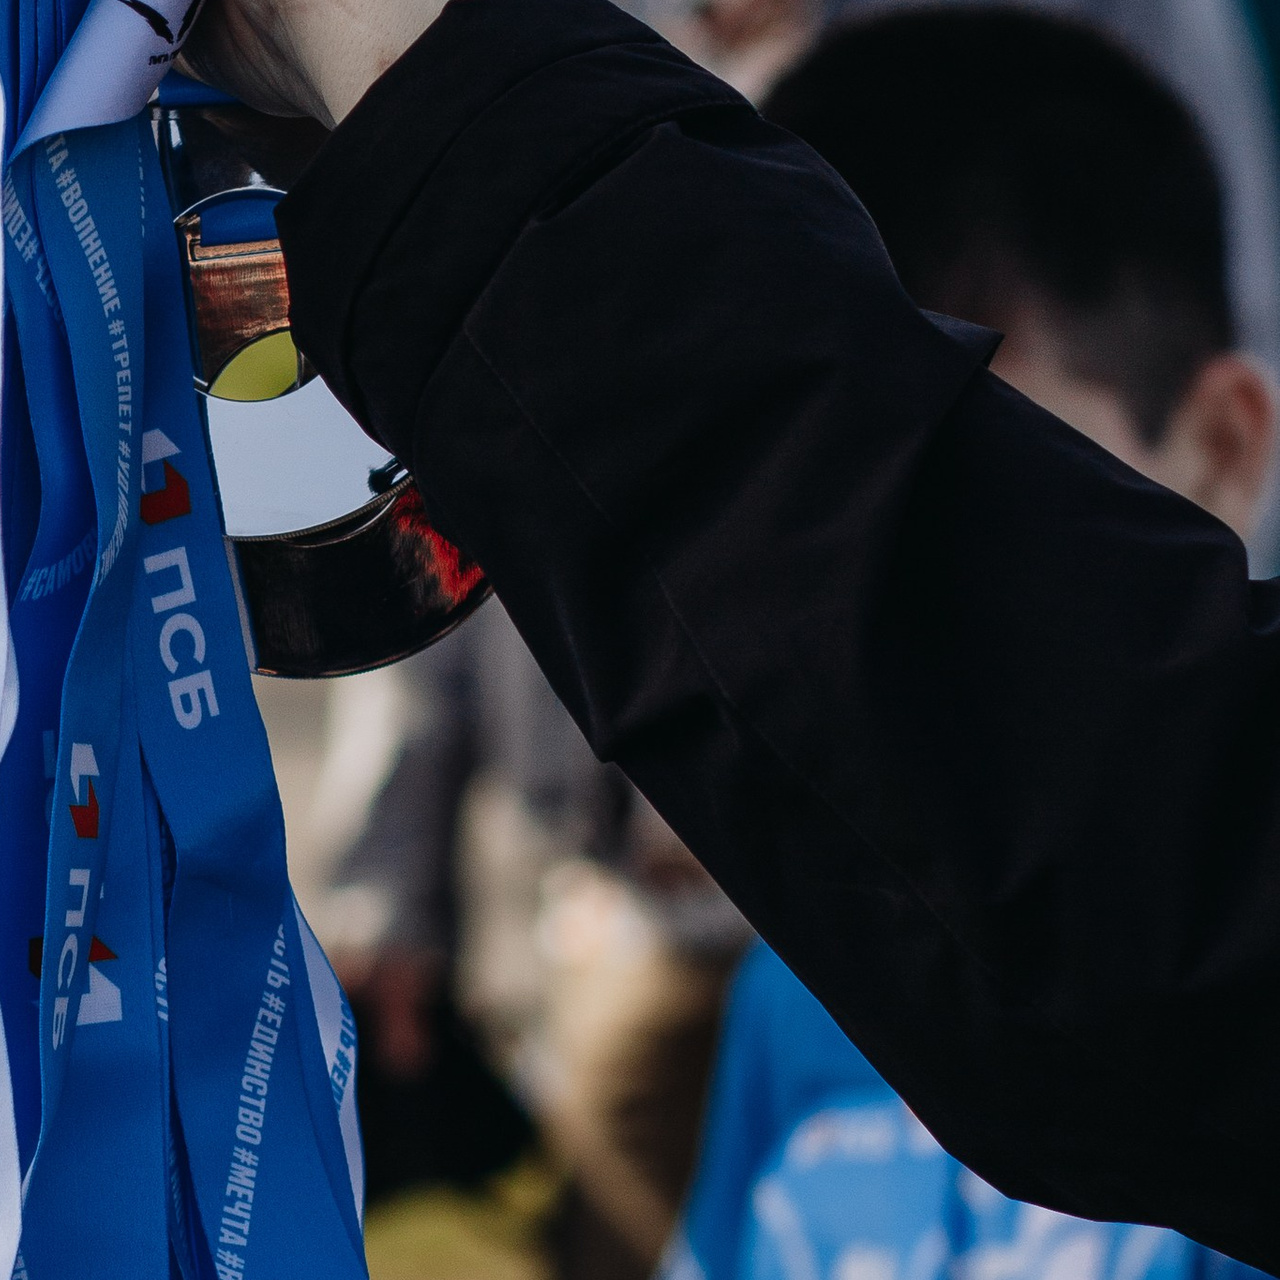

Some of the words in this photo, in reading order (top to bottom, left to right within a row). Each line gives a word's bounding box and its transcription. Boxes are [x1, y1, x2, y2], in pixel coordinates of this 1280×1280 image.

[56, 169, 123, 318] #ВОЛНЕНИЕ
[106, 318, 134, 436] #ТРЕПЕТ
[143, 545, 220, 732] ПСБ
[51, 868, 91, 1051] ПСБ
[235, 990, 287, 1144] #ЕДИНСТВО
[217, 1145, 259, 1247] #МЕЧТА
